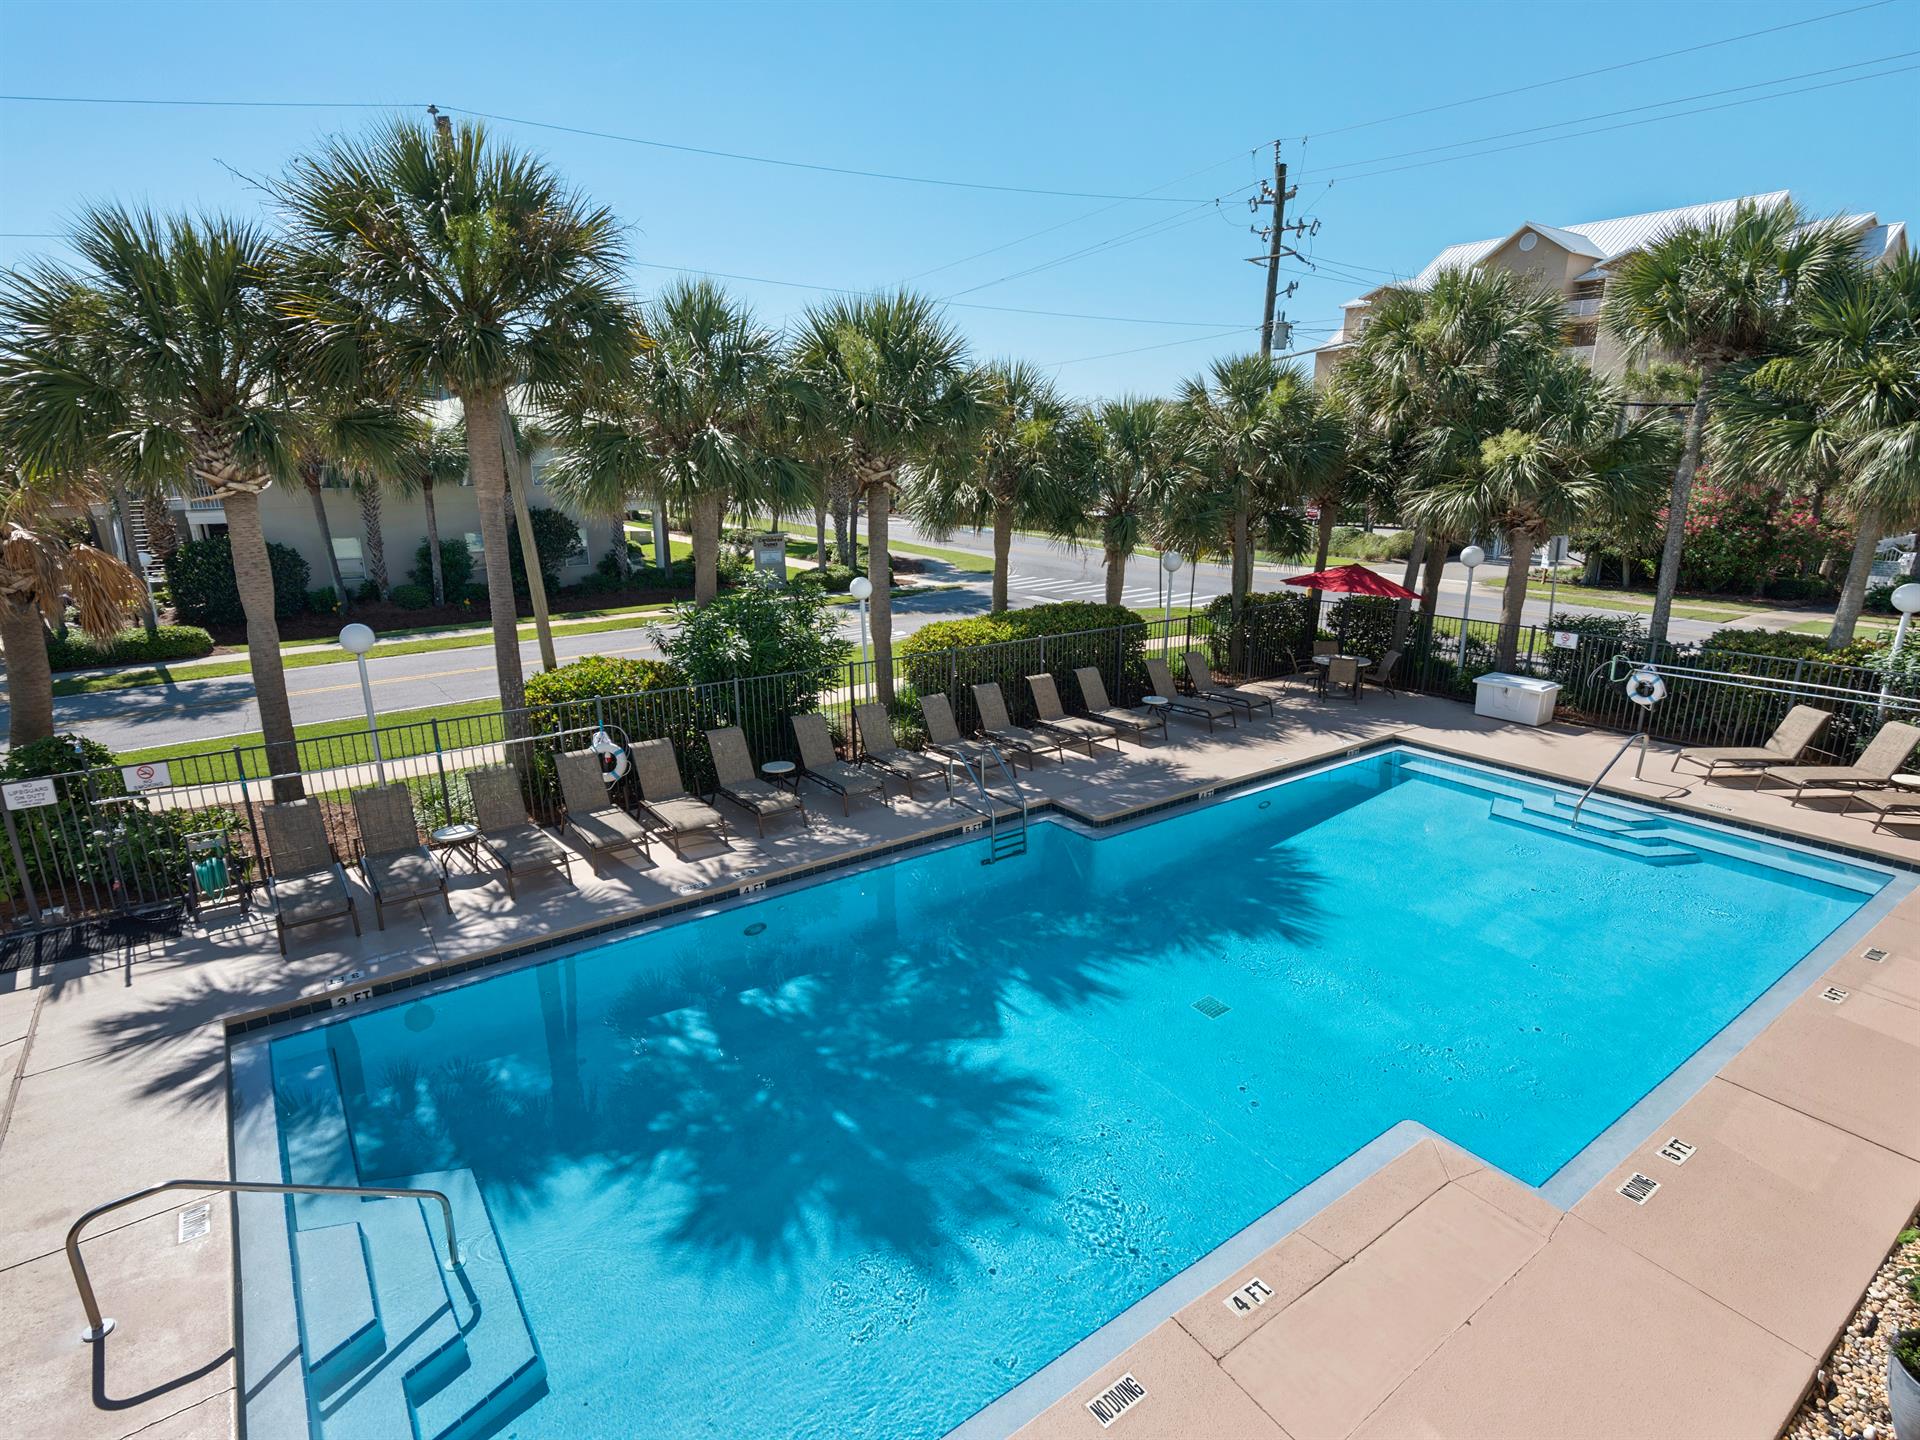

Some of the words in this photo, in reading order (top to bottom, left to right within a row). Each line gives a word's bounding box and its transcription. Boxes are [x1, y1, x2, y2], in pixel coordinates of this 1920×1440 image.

[7, 786, 49, 796] LIFEGUARD
[753, 881, 765, 891] FT
[353, 990, 370, 1002] FT
[1661, 1149, 1681, 1161] 5
[1232, 1295, 1251, 1311] 4
[1089, 1399, 1114, 1424] NO
[1102, 1377, 1145, 1414] DIVING
